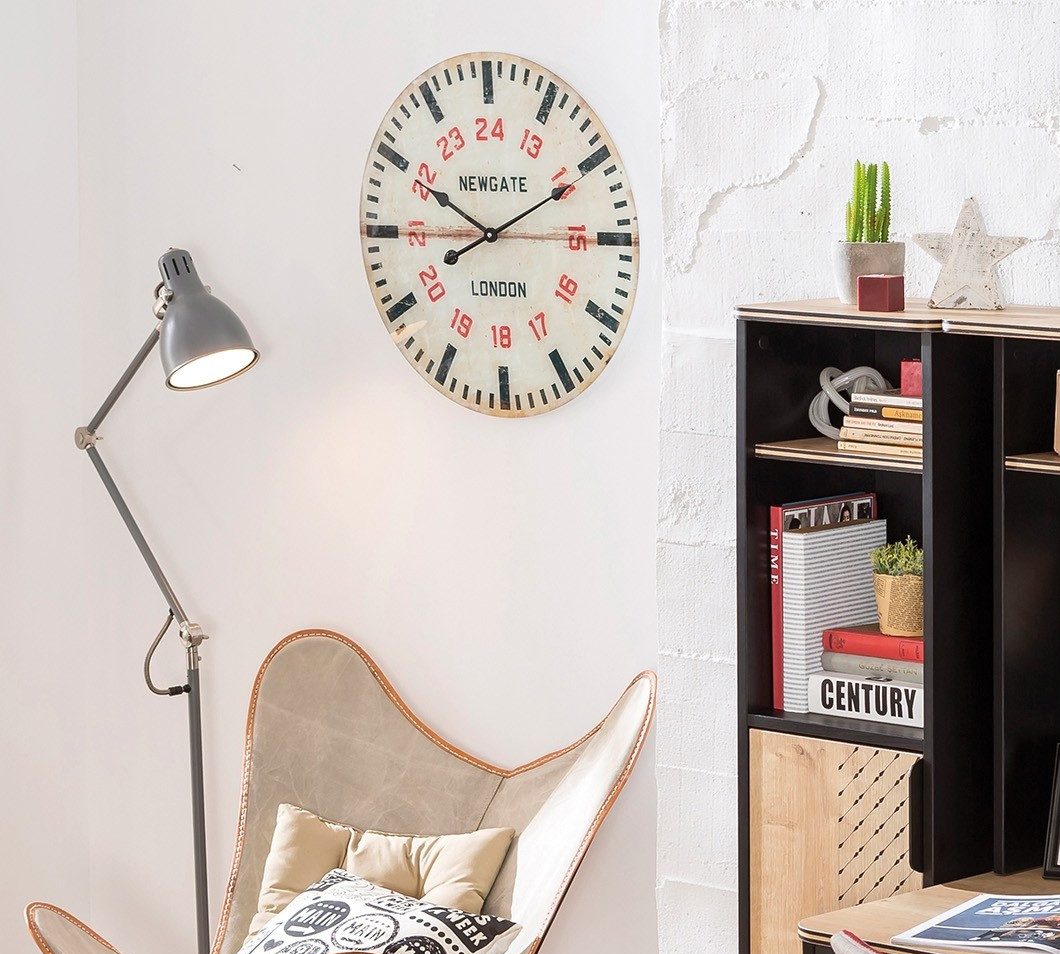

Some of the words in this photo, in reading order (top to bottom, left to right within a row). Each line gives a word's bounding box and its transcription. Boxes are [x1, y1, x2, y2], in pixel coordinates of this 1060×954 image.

[436, 127, 466, 162] 23
[474, 118, 505, 142] 24
[519, 128, 544, 160] 13
[412, 162, 437, 202] 22
[458, 175, 528, 193] NEWGATE
[408, 220, 426, 248] 21
[567, 224, 588, 252] 15
[418, 264, 446, 303] 20
[471, 280, 528, 298] LONDON
[554, 273, 579, 305] 16
[450, 308, 474, 339] 19
[491, 324, 512, 348] 18
[528, 312, 550, 342] 17
[770, 528, 779, 586] TIME
[820, 678, 917, 720] CENTURY
[290, 907, 342, 928] MAIN
[344, 921, 386, 942] MAIN
[446, 909, 488, 947] WEEK
